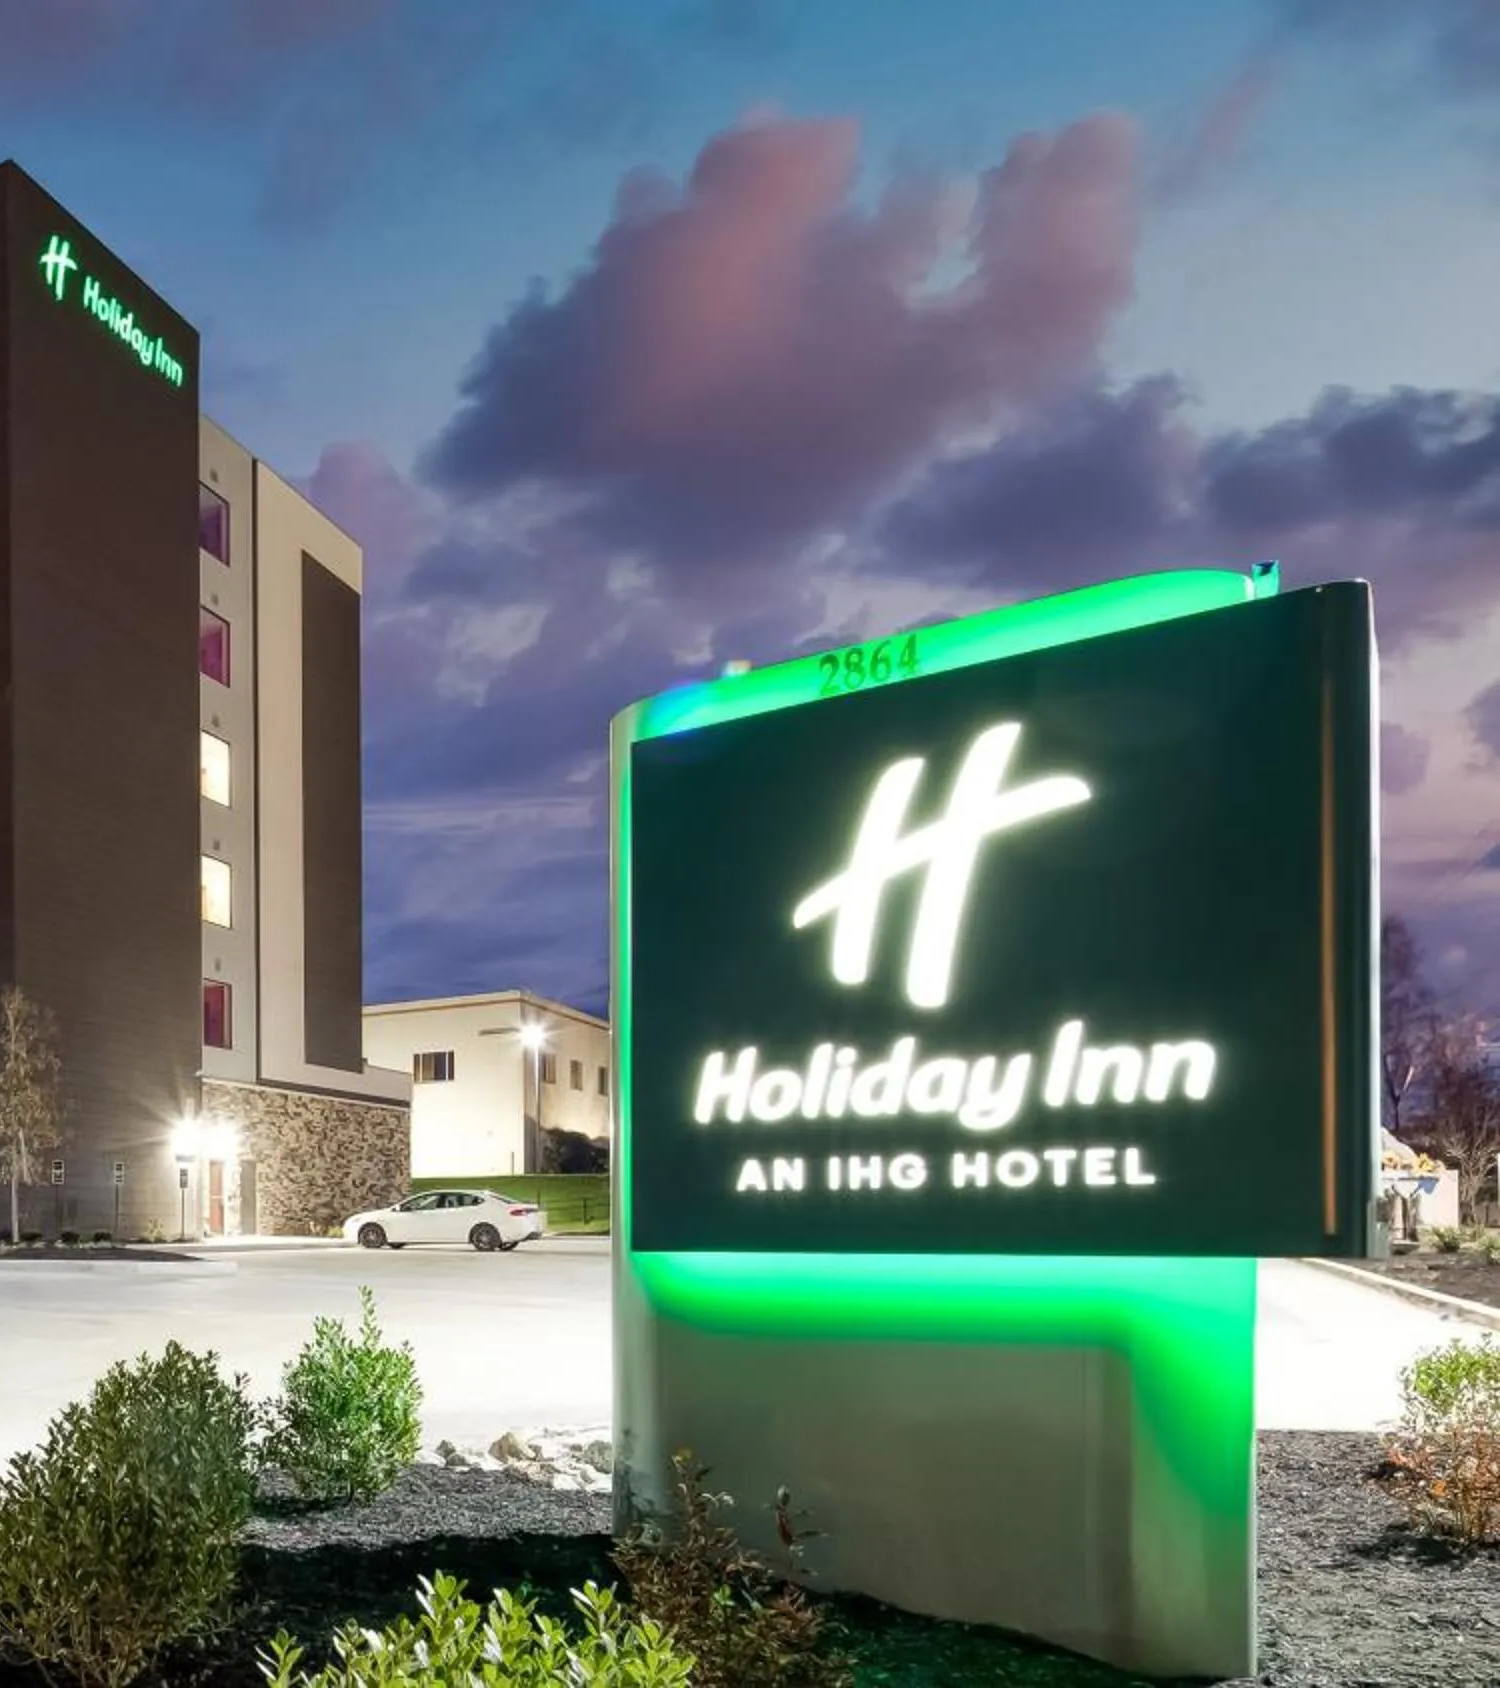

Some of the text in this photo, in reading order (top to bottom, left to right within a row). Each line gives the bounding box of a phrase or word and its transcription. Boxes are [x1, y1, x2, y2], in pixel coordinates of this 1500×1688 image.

[83, 276, 183, 387] Holiday Inn
[819, 634, 917, 696] 2864
[694, 1018, 1217, 1132] Holiday Inn
[736, 1146, 1156, 1192] AN IHG HOTEL
